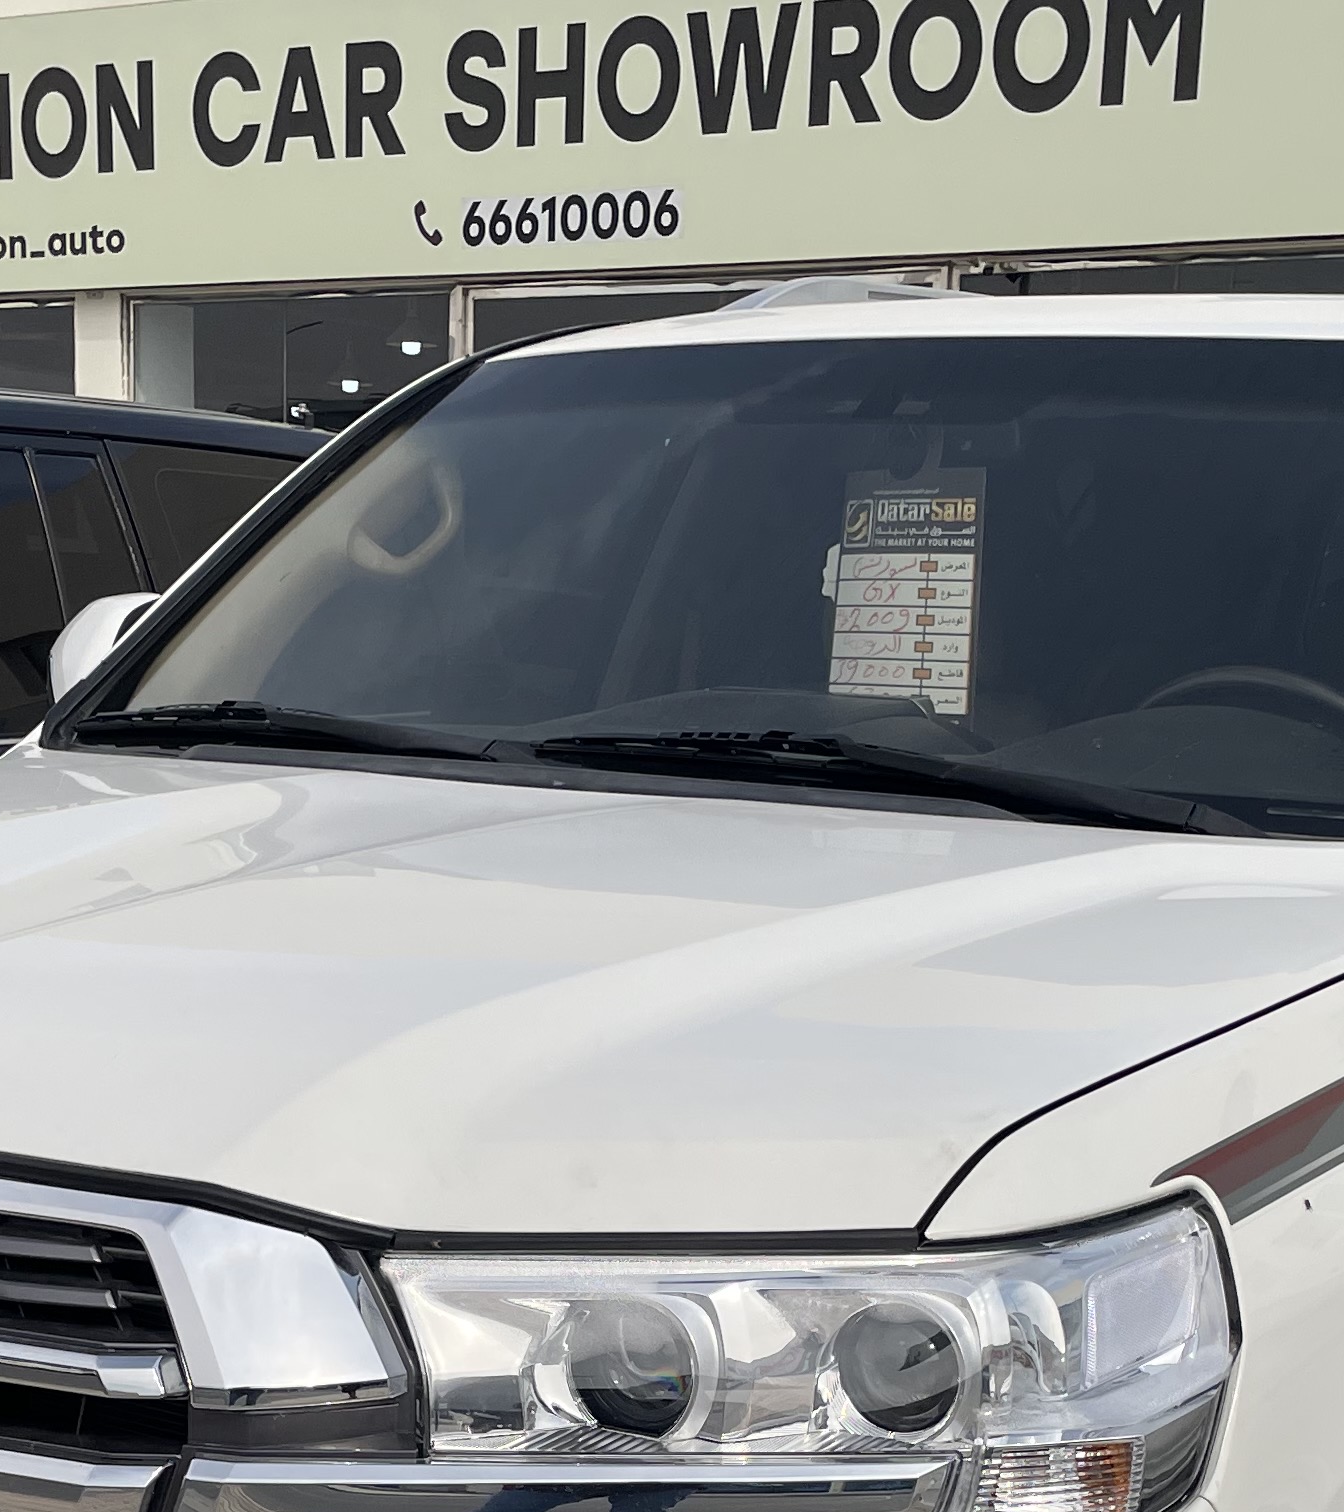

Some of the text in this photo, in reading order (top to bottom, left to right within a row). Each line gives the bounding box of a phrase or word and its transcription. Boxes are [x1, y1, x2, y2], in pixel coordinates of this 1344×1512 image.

[192, 40, 407, 168] CAR
[443, 0, 1206, 153] SHOWROOM
[460, 187, 681, 248] 66610006
